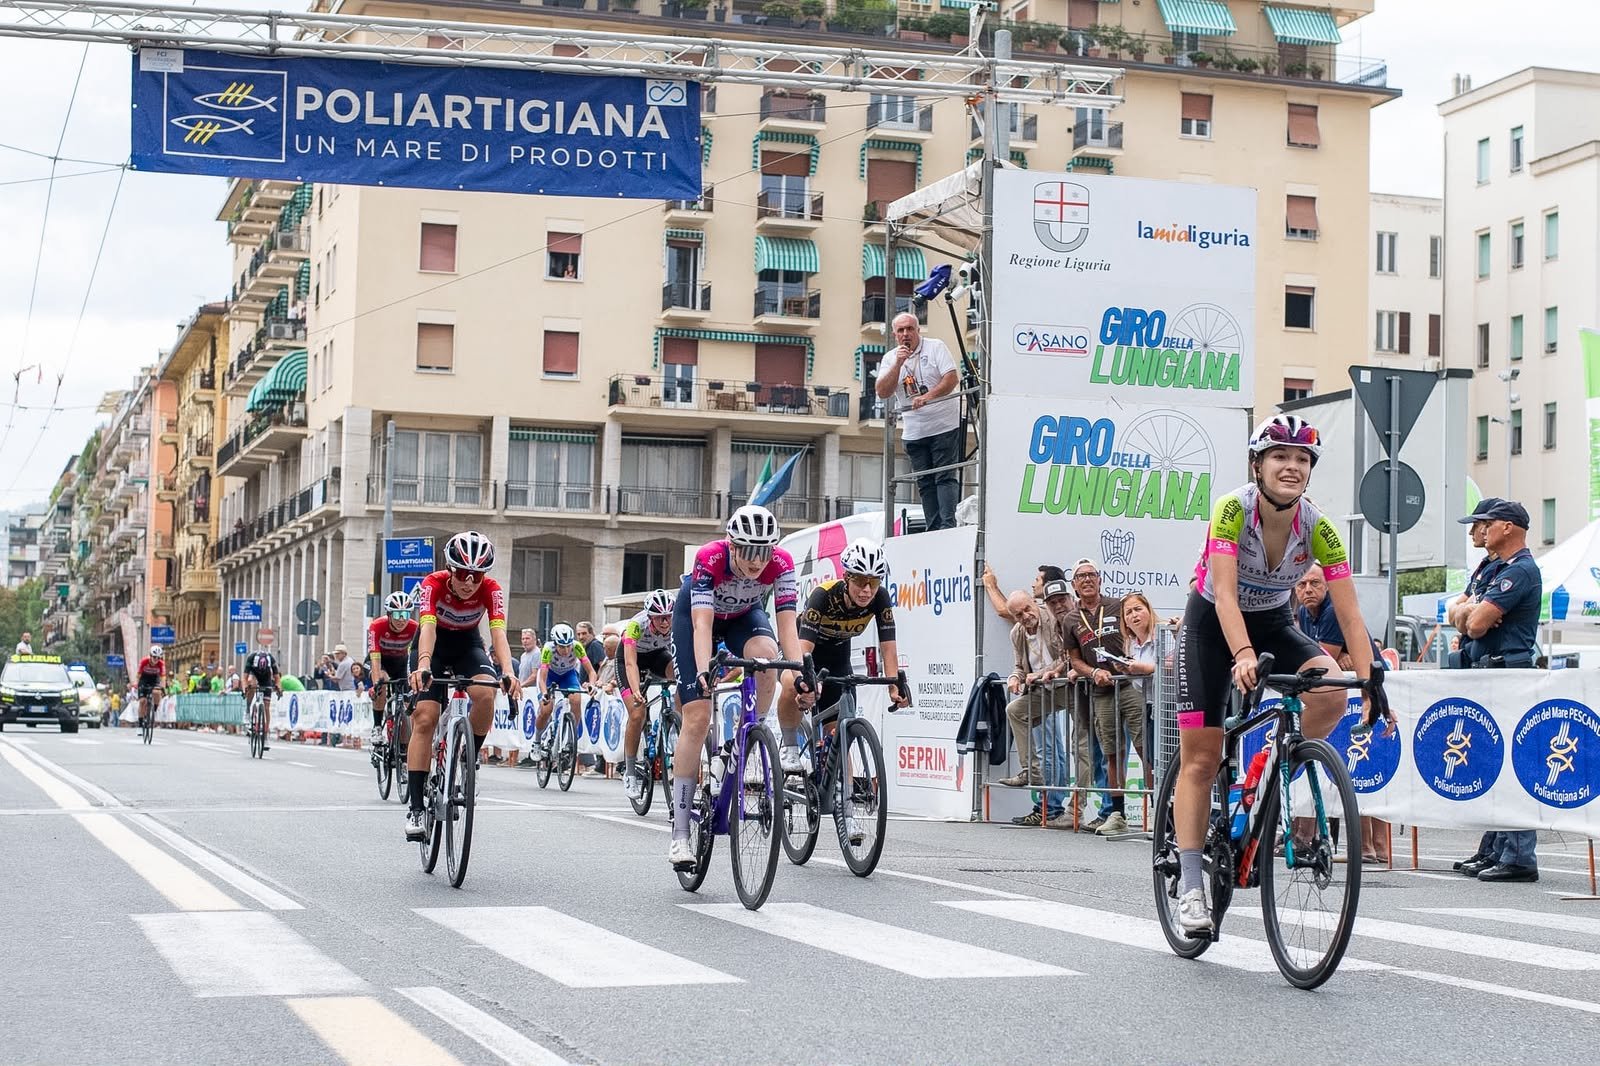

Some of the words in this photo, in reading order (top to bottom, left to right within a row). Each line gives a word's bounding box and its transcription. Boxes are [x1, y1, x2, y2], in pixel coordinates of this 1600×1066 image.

[296, 86, 670, 140] POLIARTIGIANA
[295, 135, 335, 155] UN
[356, 139, 441, 160] MARE
[462, 144, 489, 162] DI
[510, 146, 667, 170] PRODOTTI
[1137, 220, 1250, 249] lamialiguria
[1009, 253, 1061, 270] Regione
[1064, 256, 1112, 273] Liguria
[1016, 331, 1088, 352] CASANO
[1099, 306, 1167, 348] GIRO
[1162, 336, 1194, 349] DELLA
[1089, 344, 1240, 391] LUNIGIANA
[1028, 414, 1116, 466] GIRO
[1111, 451, 1150, 469] DELLA
[1017, 464, 1211, 521] LUNIGIANA
[1064, 567, 1180, 586] CINDUSTRIA
[21, 655, 61, 663] SUZUKI
[928, 663, 955, 676] MEMORIAL
[1178, 625, 1189, 697] GAUSSMAGNETI
[918, 682, 943, 695] MASSIMO
[1416, 708, 1439, 741] Prodotti
[1438, 704, 1448, 718] del
[1448, 704, 1464, 717] Mare
[1463, 705, 1499, 745] PESCANDIA
[1515, 710, 1541, 745] Prodotti
[1540, 706, 1551, 721] del
[1551, 706, 1569, 719] Mare
[898, 745, 946, 772] SEPRIN
[1434, 776, 1472, 798] Poliartigiana
[1472, 777, 1483, 790] Srl
[1533, 782, 1578, 805] Poliartigiana
[1578, 784, 1590, 798] Srl
